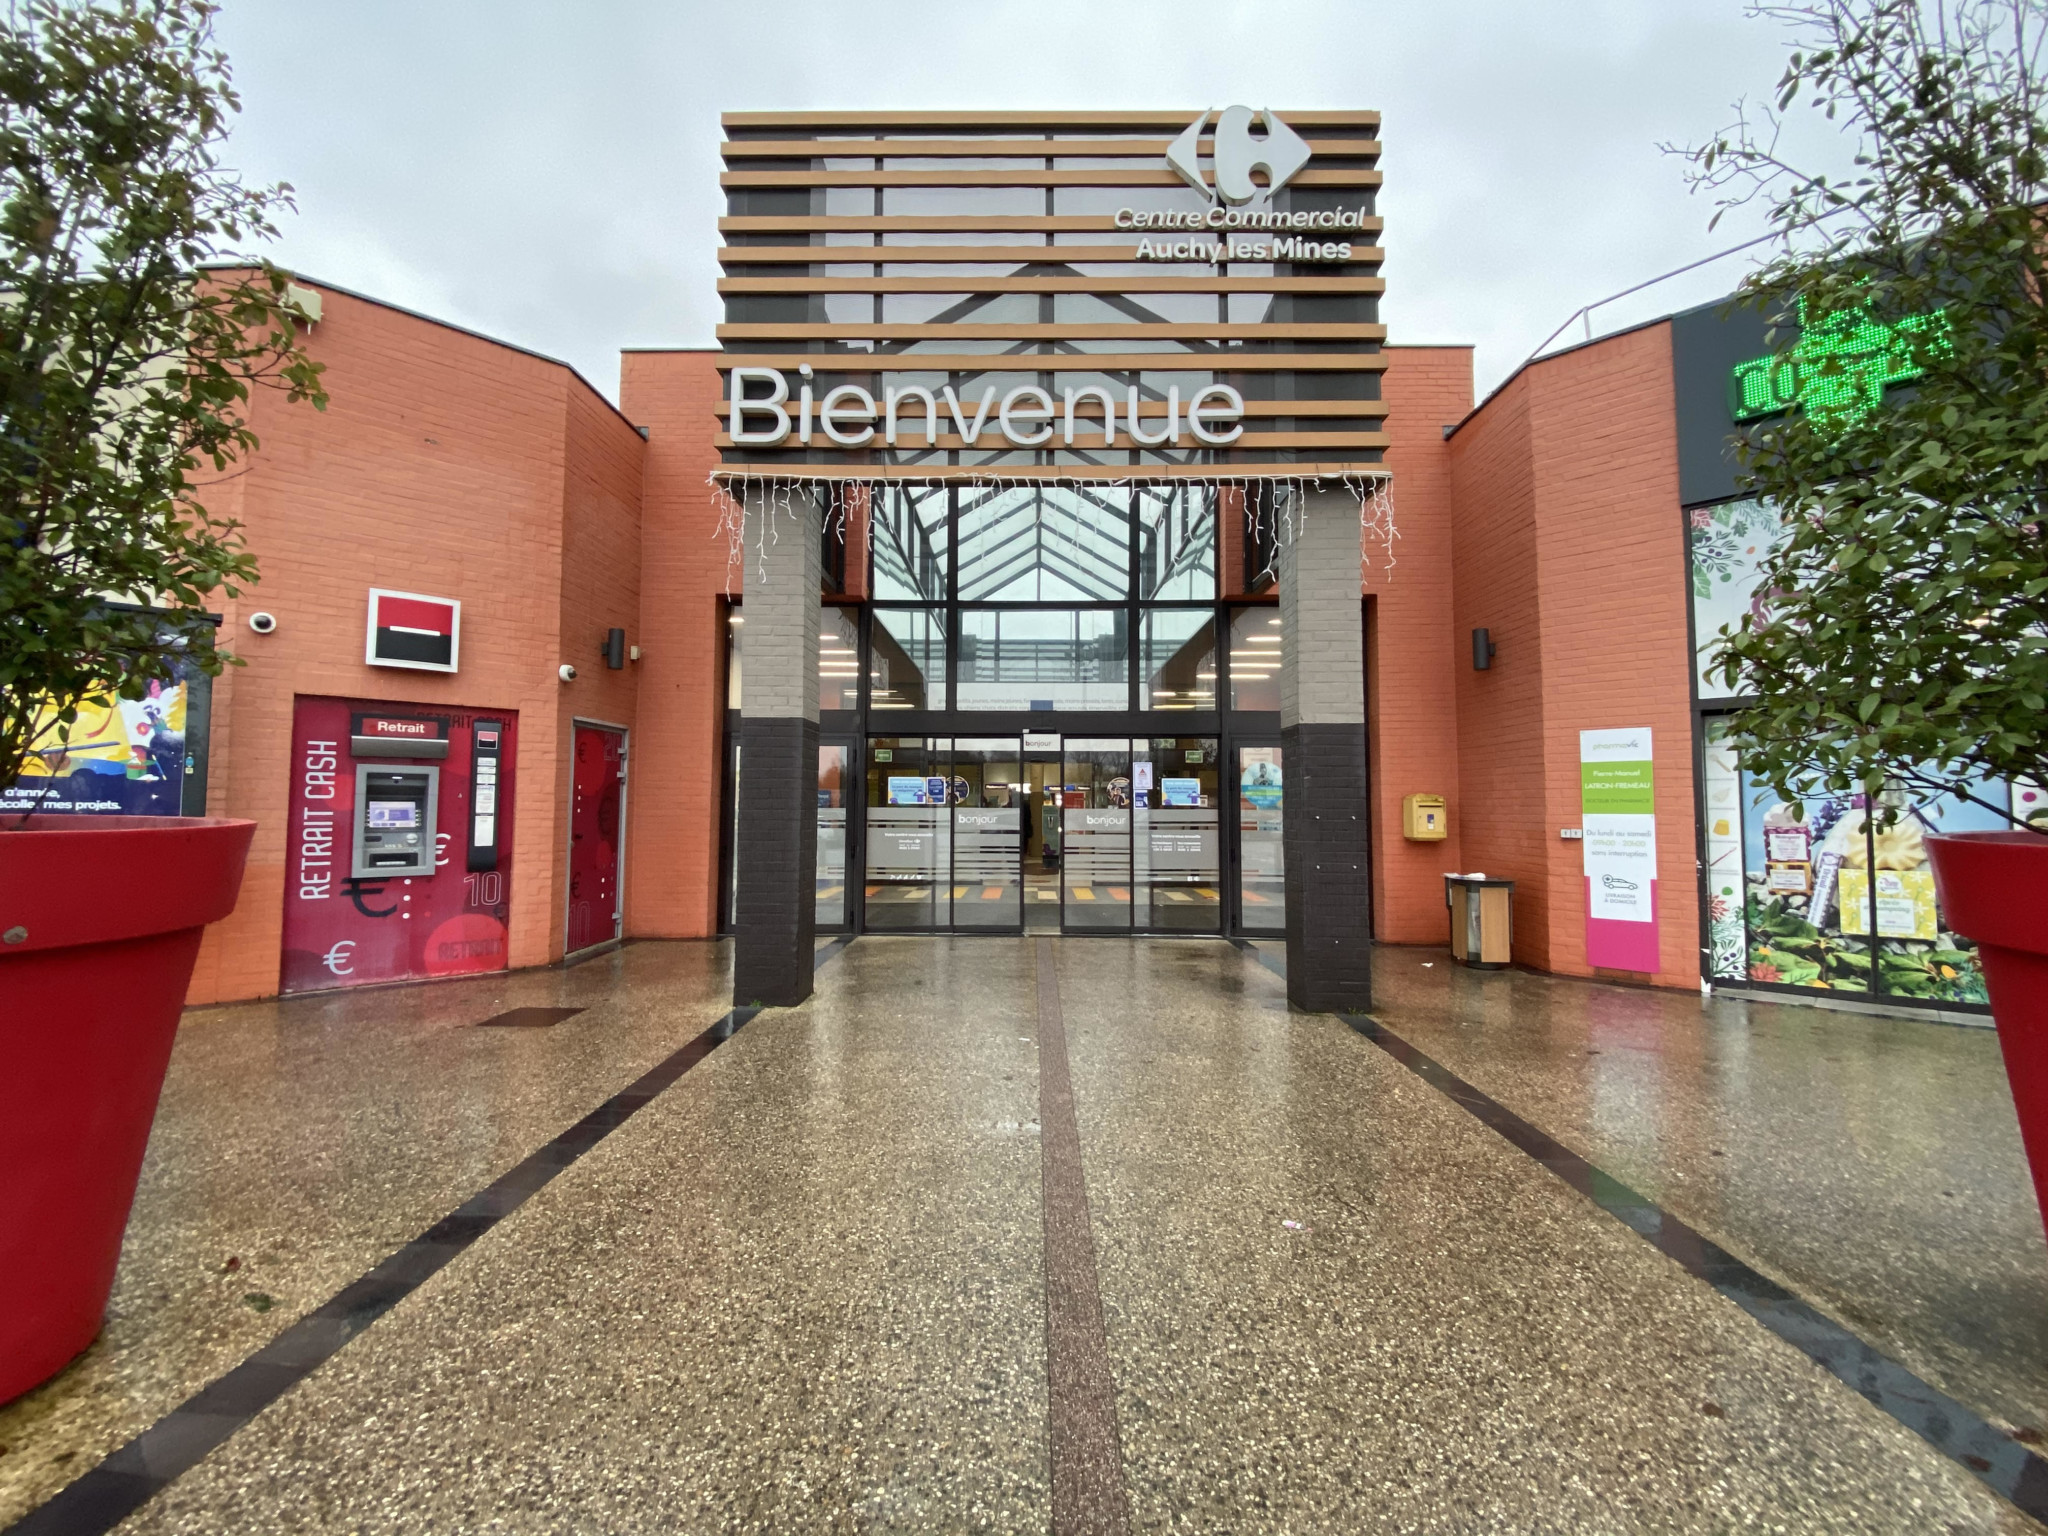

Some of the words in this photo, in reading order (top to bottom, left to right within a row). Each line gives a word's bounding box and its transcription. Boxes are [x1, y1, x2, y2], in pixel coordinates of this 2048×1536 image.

[1114, 206, 1202, 229] Centre
[1206, 206, 1366, 229] Commercial
[1136, 237, 1223, 263] Auchy
[1227, 237, 1267, 260] les
[1271, 237, 1352, 260] Mines
[728, 363, 1246, 448] Bienvenue
[378, 721, 425, 733] Retrait
[1025, 740, 1051, 748] bonjour
[304, 740, 337, 799] CASH
[43, 801, 72, 809] mes
[75, 800, 122, 811] projets.
[958, 814, 998, 825] bonjour
[1086, 815, 1126, 826] bonjour
[300, 807, 334, 900] RETRAIT
[464, 872, 502, 907] 10
